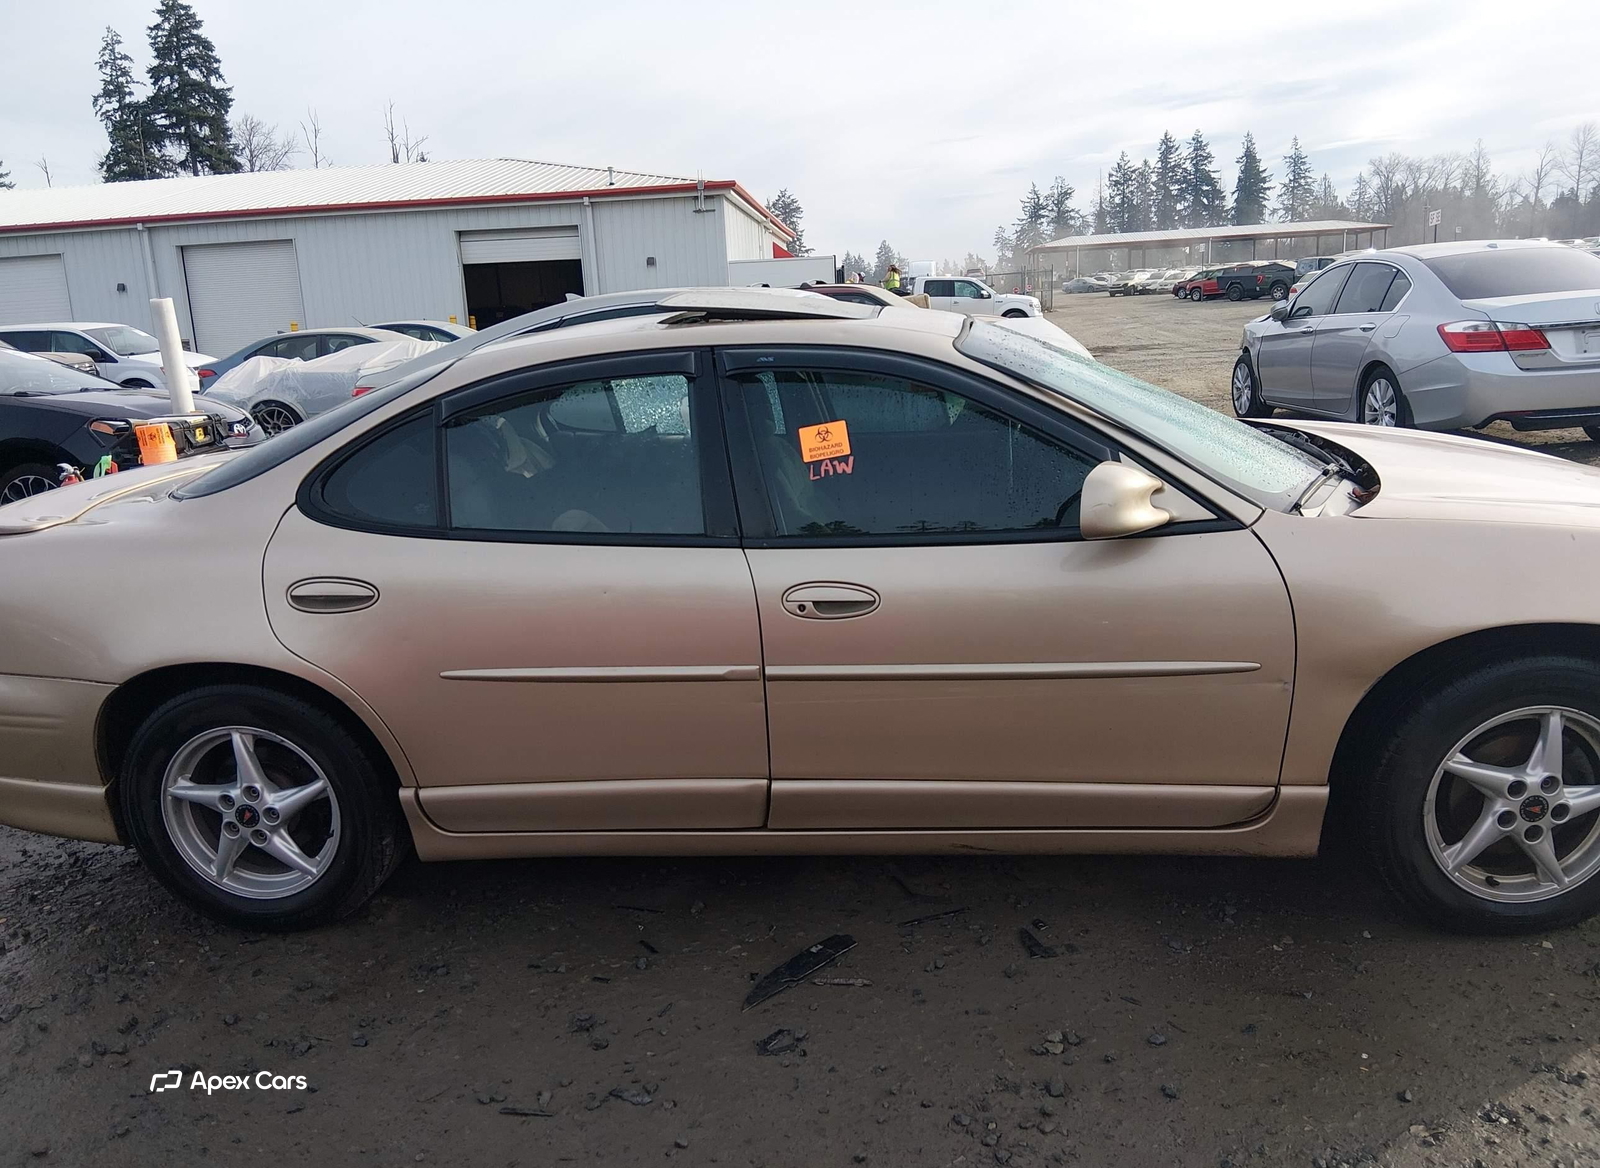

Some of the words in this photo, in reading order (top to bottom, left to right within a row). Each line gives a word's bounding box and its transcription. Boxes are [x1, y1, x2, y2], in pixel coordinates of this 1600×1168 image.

[808, 442, 843, 453] BIOHAZARD
[809, 448, 845, 460] BIOPELIGRO
[810, 456, 854, 480] LAW
